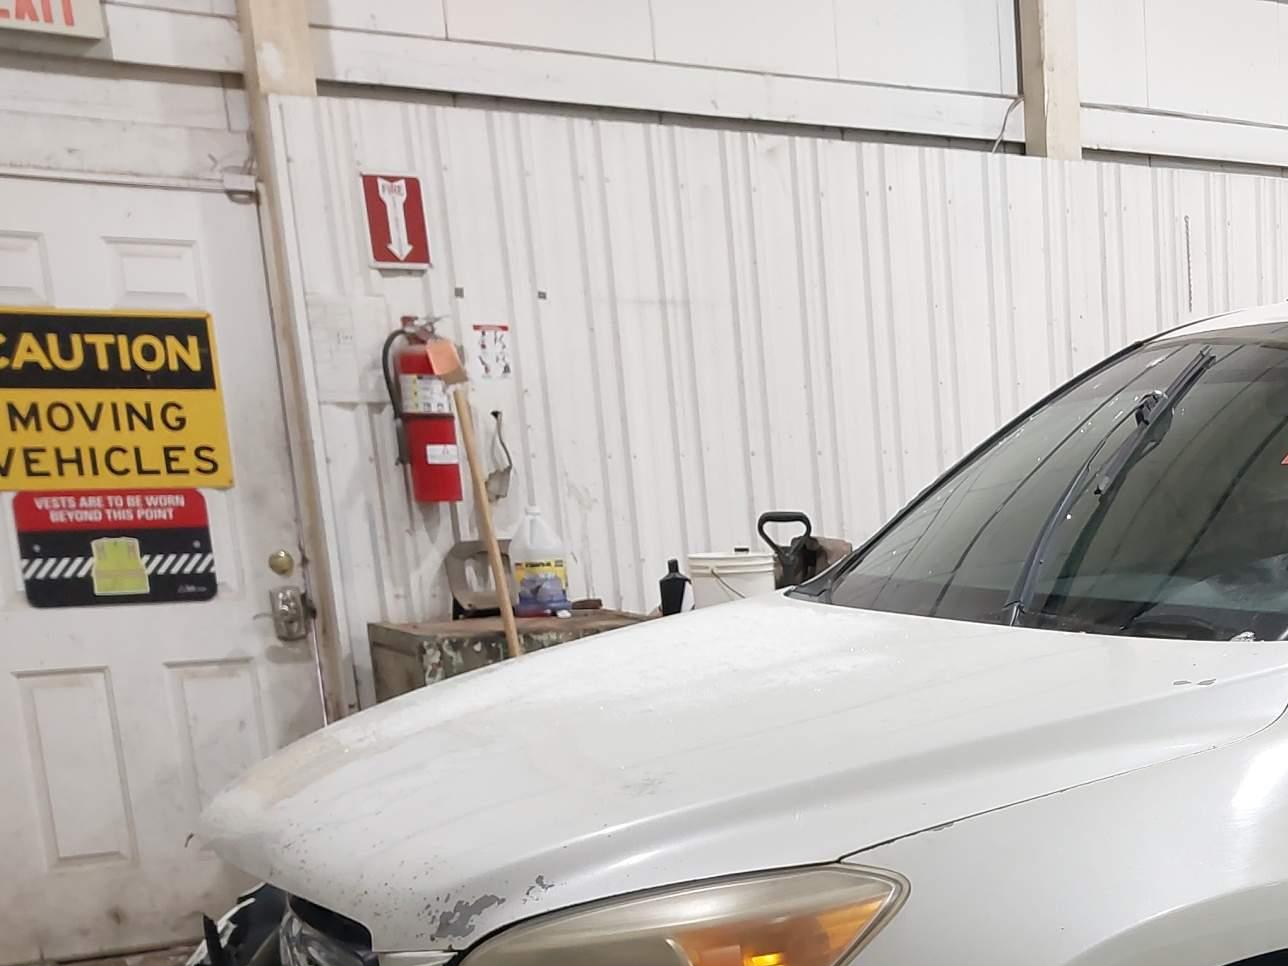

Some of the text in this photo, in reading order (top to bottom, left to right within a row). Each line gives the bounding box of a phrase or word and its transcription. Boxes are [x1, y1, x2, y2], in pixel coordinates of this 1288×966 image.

[7, 401, 187, 432] MOVING
[34, 494, 185, 509] VESTS ARE TO BE WORN
[49, 508, 175, 522] BEYOND THIS POINT
